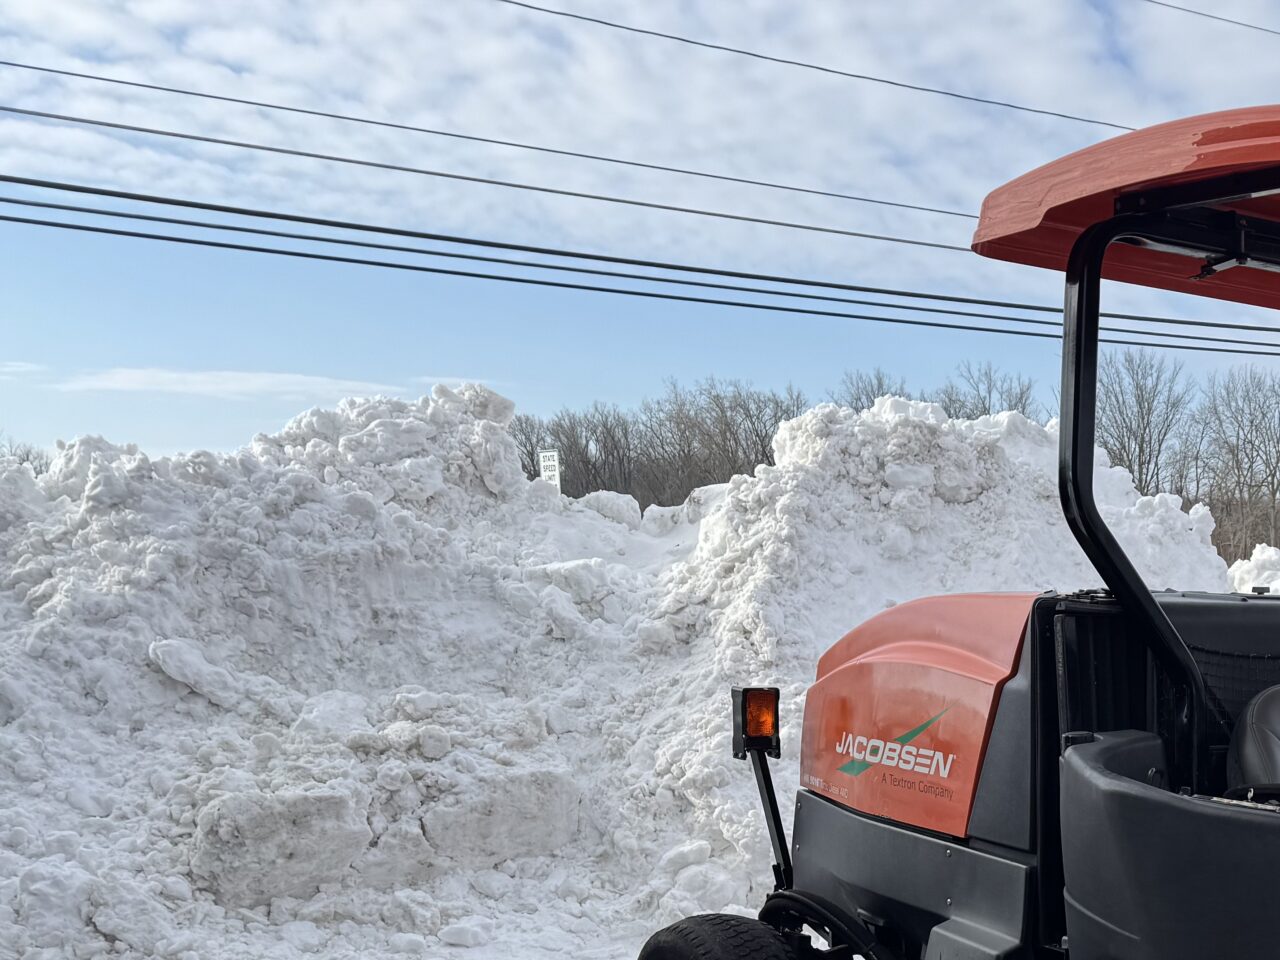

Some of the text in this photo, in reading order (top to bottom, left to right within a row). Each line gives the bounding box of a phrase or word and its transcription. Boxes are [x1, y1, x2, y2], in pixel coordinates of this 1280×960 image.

[835, 731, 954, 778] JACOBSEN
[881, 772, 954, 801] A Textron Company
